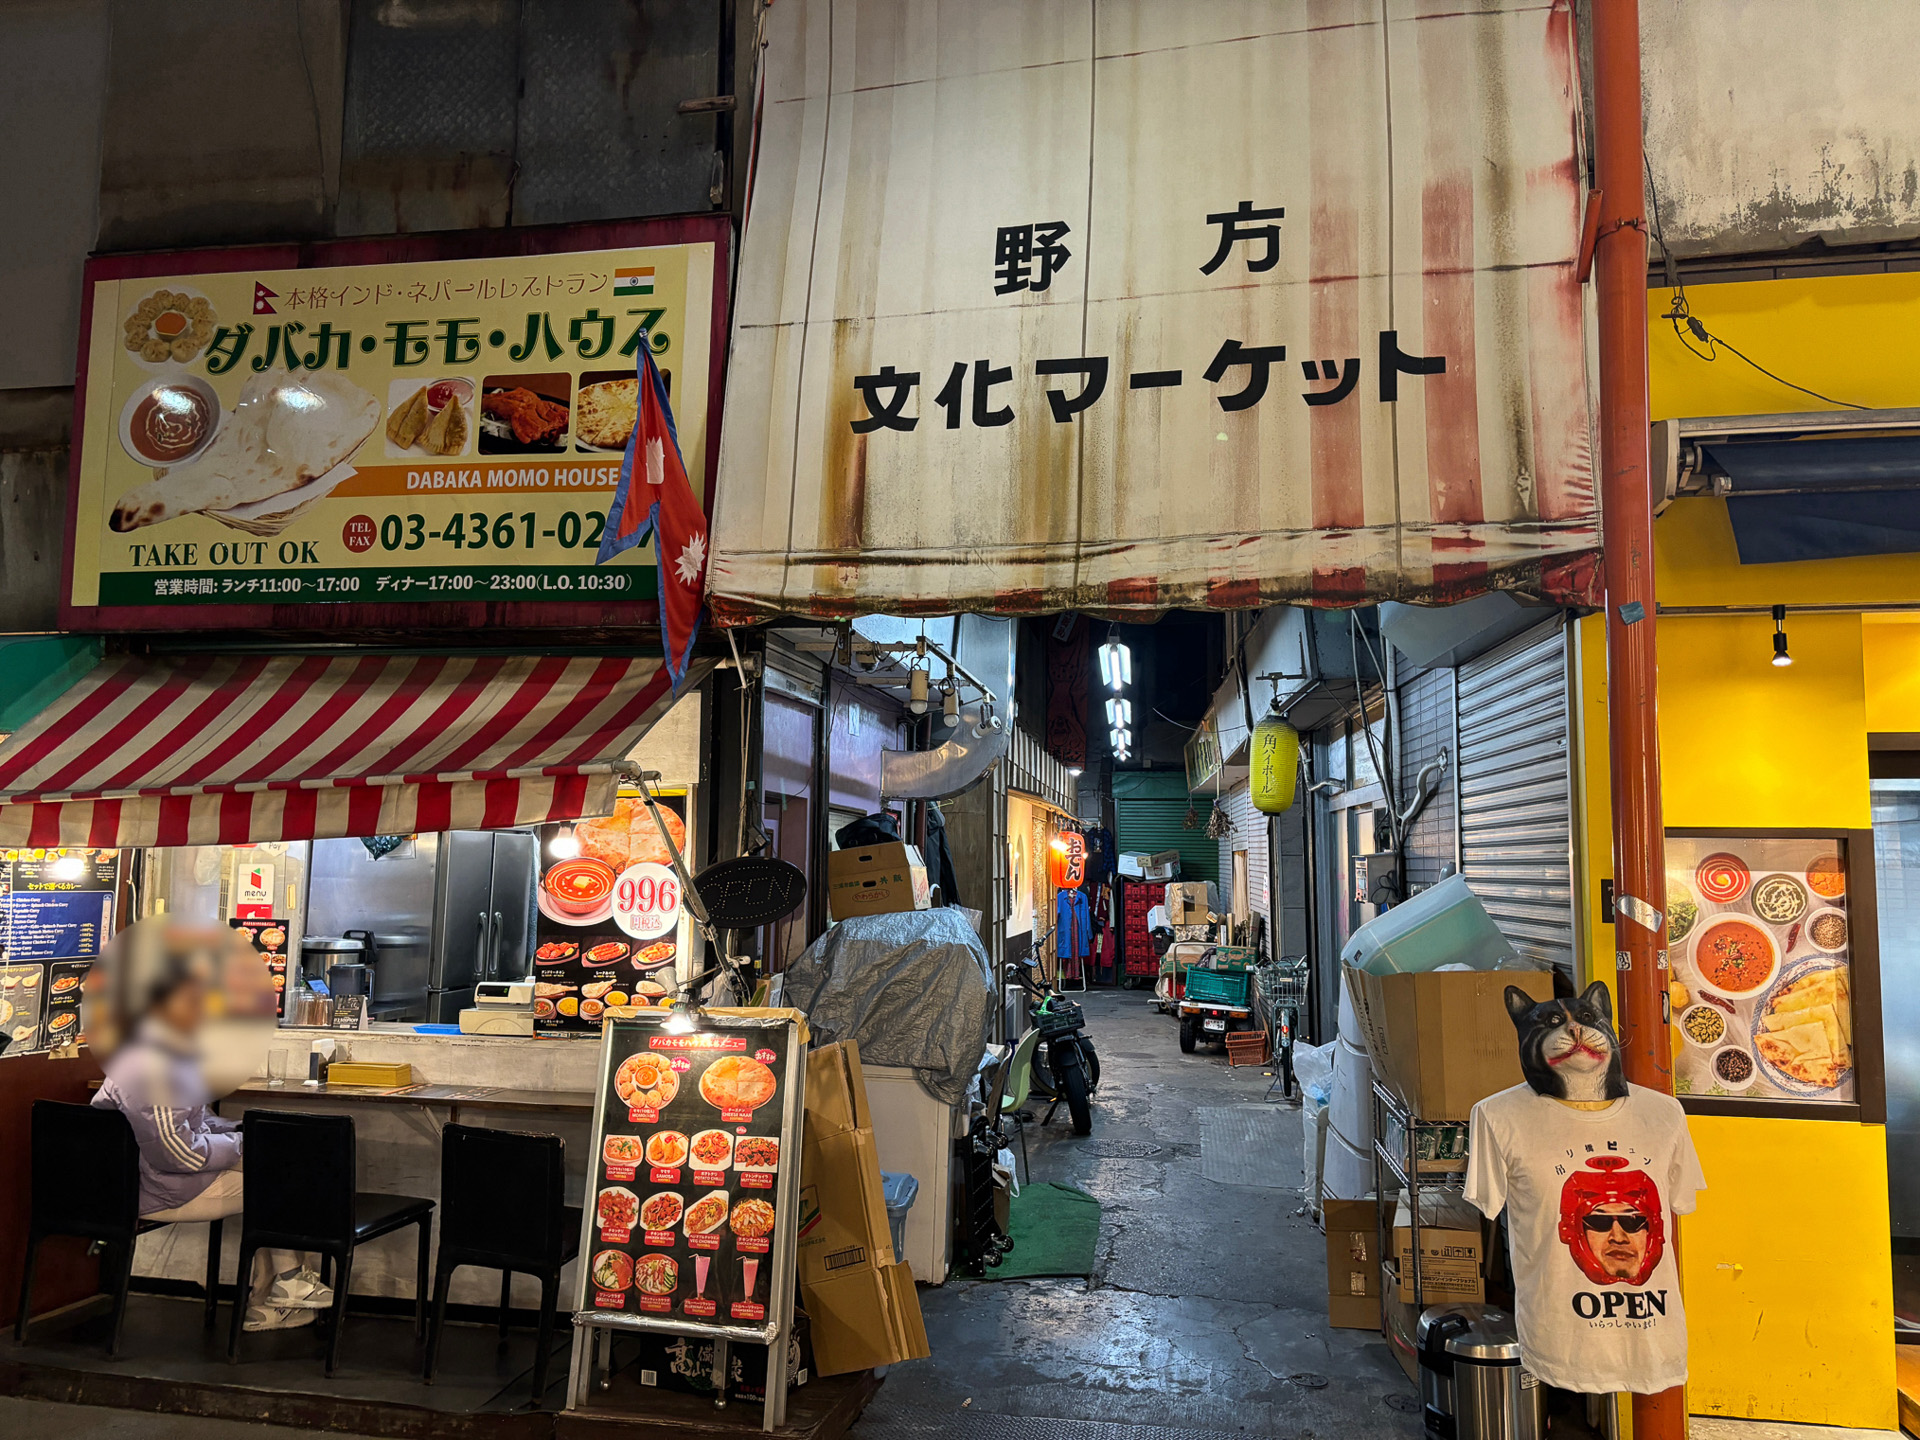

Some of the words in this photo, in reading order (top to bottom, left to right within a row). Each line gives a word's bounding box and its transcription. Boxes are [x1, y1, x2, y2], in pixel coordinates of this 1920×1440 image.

[284, 272, 608, 310] 本格インド・ネパールレストラン
[204, 307, 671, 376] ダバカ・モモ・ハウス
[850, 330, 1447, 435] 文化マーケット
[406, 470, 482, 490] DABAKA
[486, 468, 549, 488] MOMO
[554, 467, 619, 486] HOUSE
[349, 535, 371, 546] FAX
[350, 522, 371, 533] TEL
[129, 542, 198, 567] TAKE
[209, 542, 268, 565] OUT
[278, 540, 320, 565] OK
[1261, 733, 1277, 794] 角ハイボール
[1065, 838, 1082, 881] おでん
[618, 877, 677, 913] 996
[1571, 1289, 1667, 1319] OPEN
